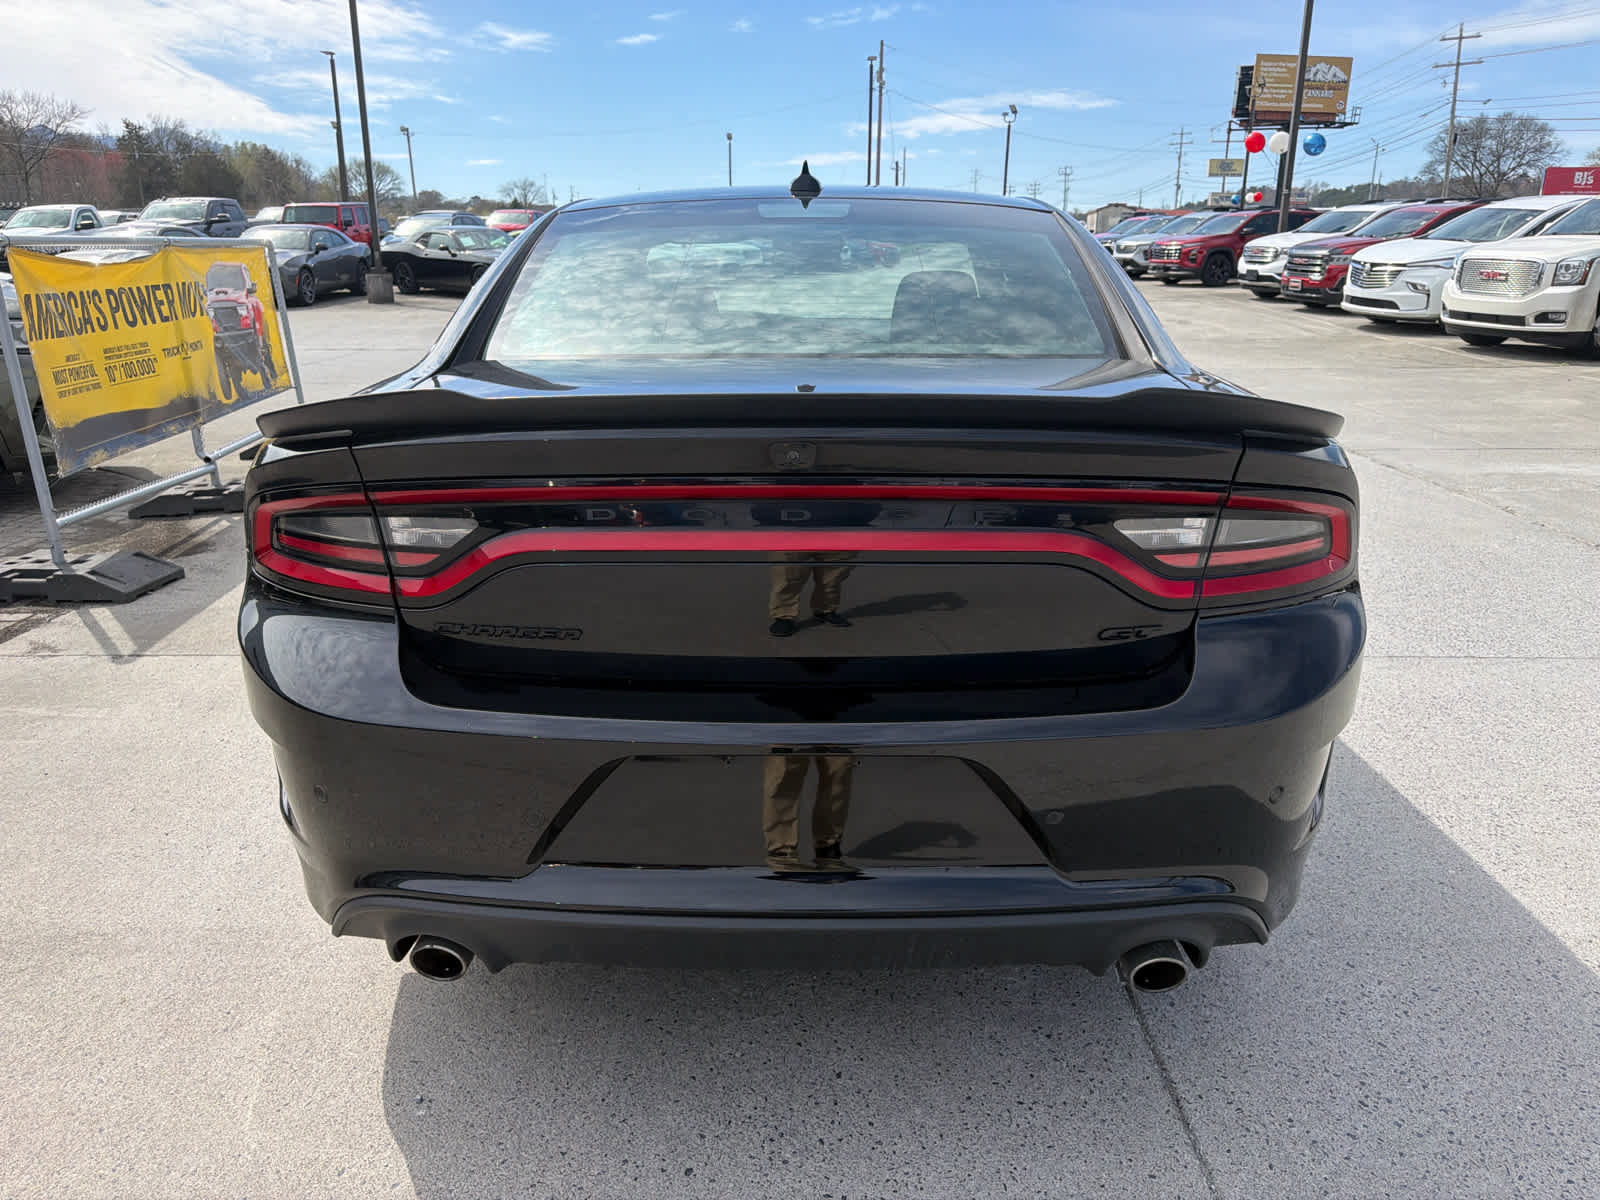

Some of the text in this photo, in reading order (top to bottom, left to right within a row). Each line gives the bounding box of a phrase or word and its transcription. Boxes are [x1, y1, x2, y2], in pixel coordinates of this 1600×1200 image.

[23, 281, 209, 342] AMERICA'S POWER MOV
[434, 622, 583, 640] CHARGER
[1098, 624, 1163, 639] GT
